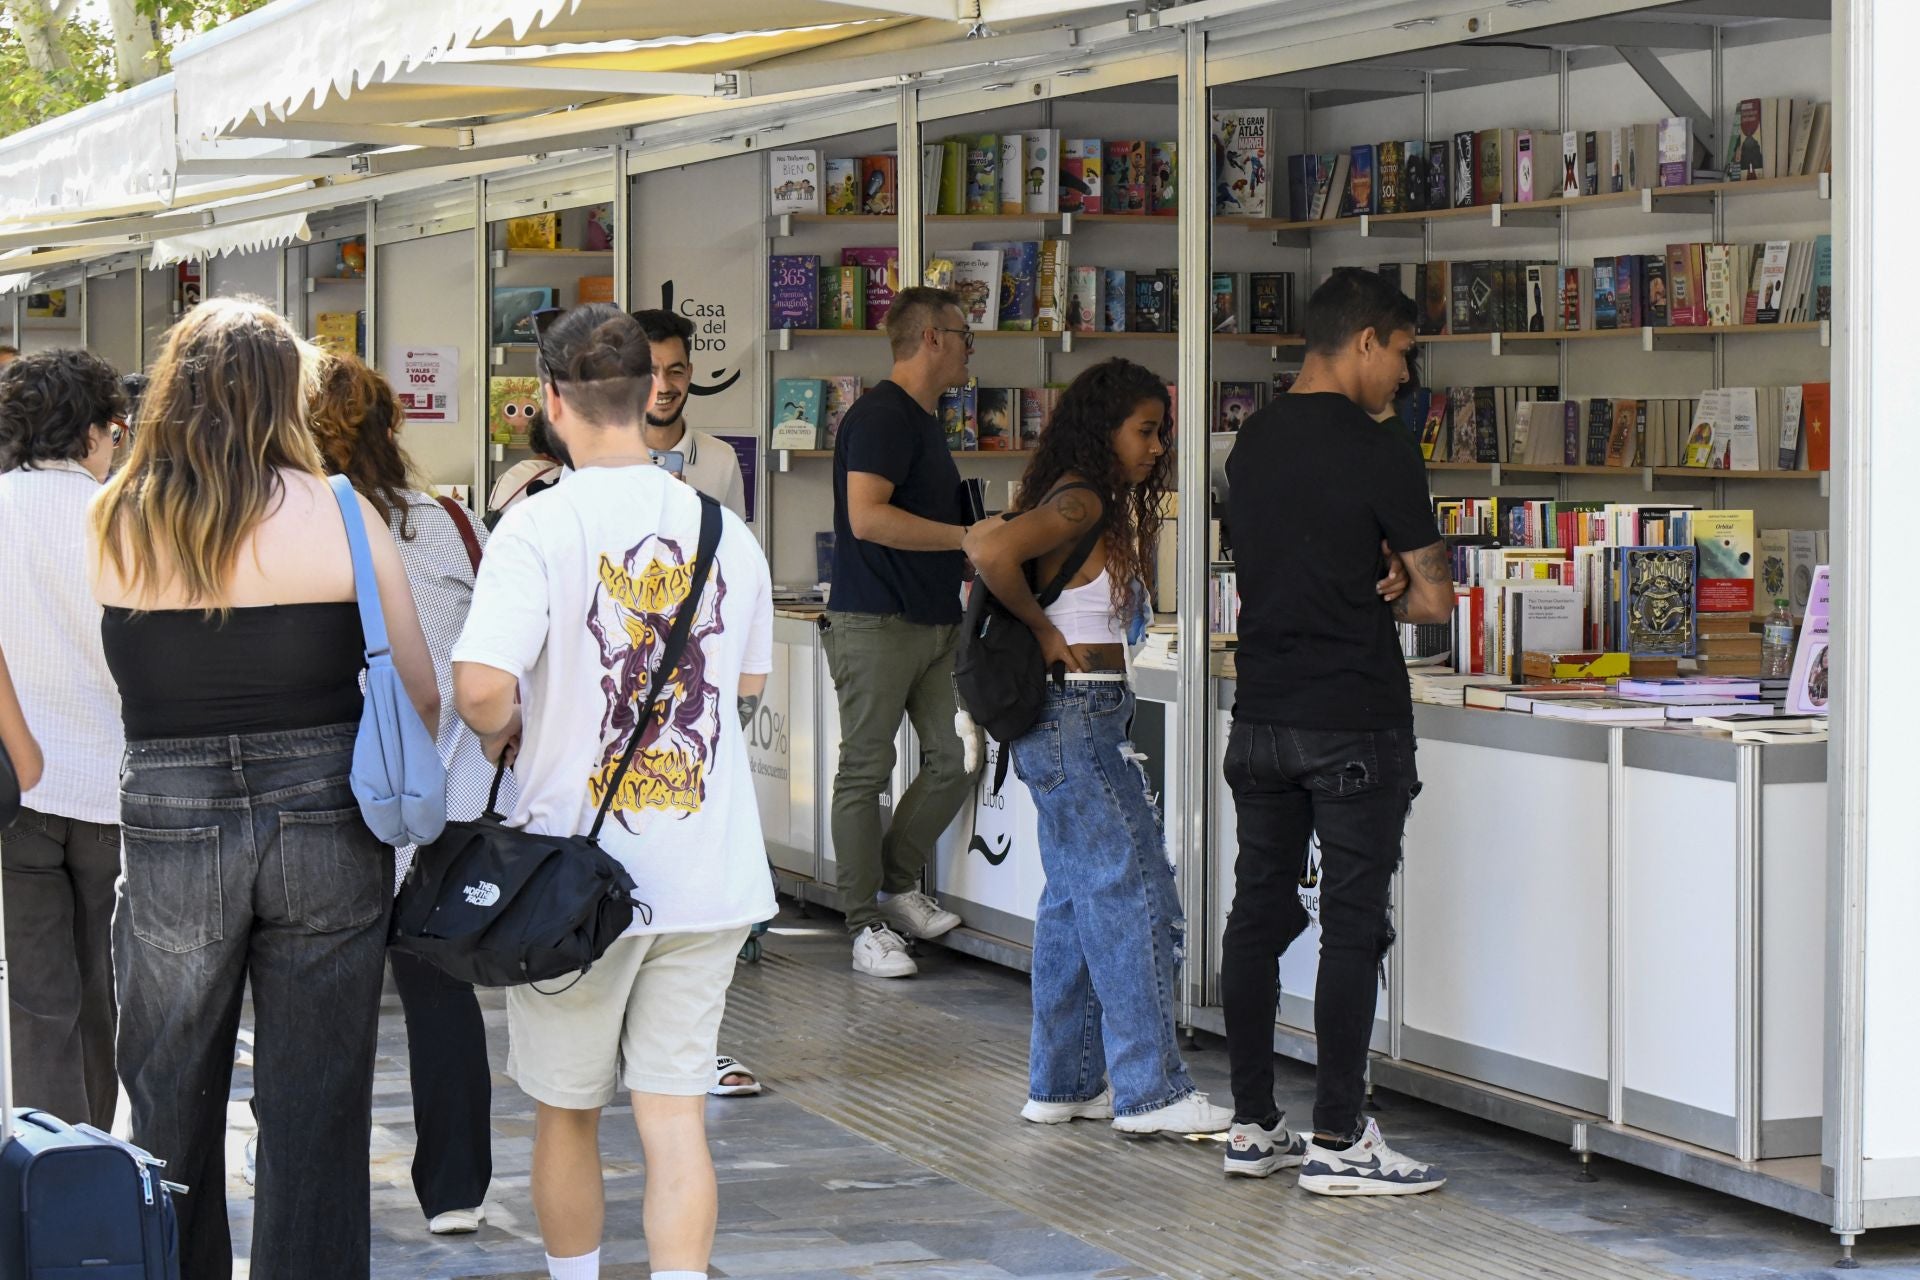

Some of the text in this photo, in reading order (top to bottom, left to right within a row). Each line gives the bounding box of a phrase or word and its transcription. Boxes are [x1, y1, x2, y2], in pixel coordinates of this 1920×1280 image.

[1238, 116, 1265, 126] EL GRAN
[1238, 125, 1264, 137] ATLAS
[1238, 137, 1264, 149] MARVEL
[778, 268, 806, 286] 365
[680, 298, 725, 317] Casa
[703, 320, 726, 334] del
[688, 333, 726, 351] ibro
[409, 374, 436, 383] 100€
[757, 758, 788, 780] descuento
